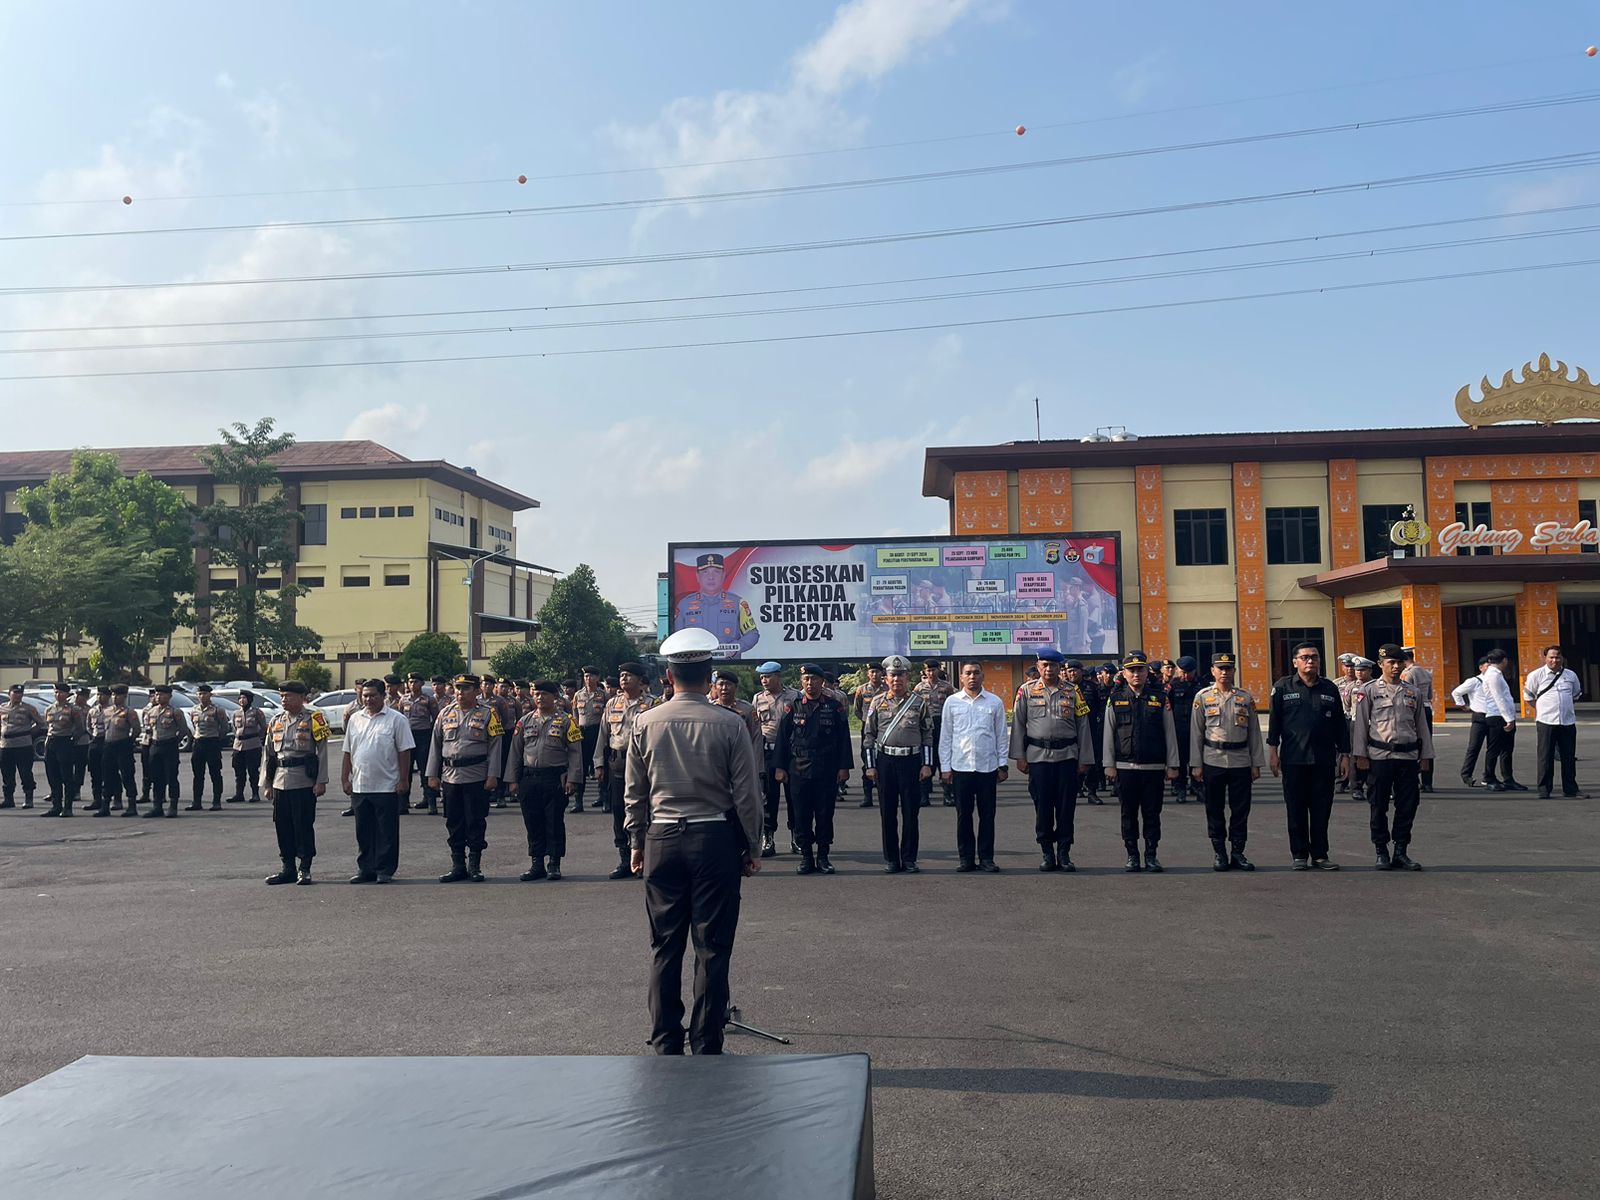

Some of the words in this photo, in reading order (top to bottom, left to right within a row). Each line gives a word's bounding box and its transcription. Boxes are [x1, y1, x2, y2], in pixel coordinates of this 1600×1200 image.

[1439, 522, 1522, 552] Gedung
[1531, 520, 1600, 545] Serba
[750, 564, 864, 584] SUKSESKAN
[765, 584, 847, 603] PILKADA
[760, 603, 856, 622] SERENTAK
[783, 623, 833, 641] 2024
